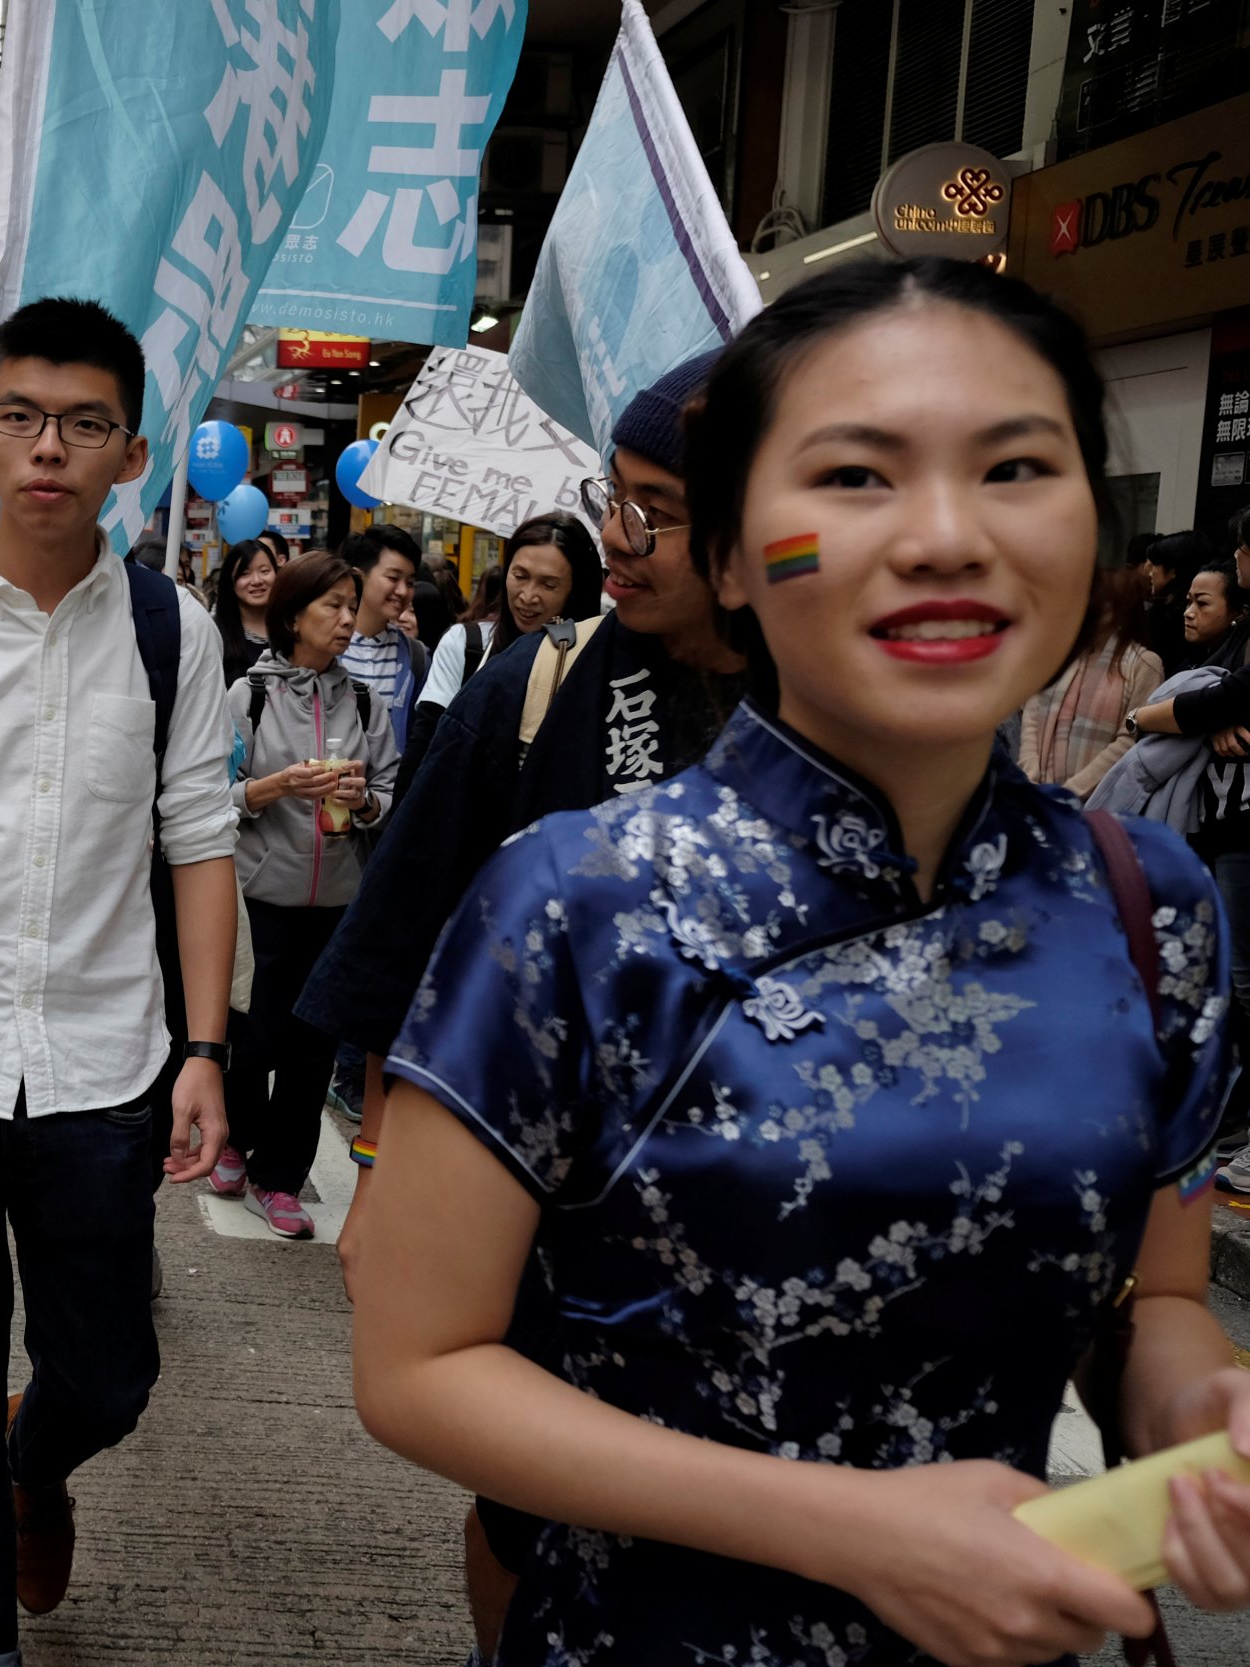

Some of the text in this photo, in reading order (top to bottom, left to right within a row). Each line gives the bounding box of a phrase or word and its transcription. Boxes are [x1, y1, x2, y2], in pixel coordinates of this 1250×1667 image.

[893, 203, 937, 219] China
[1082, 173, 1161, 248] DBS
[389, 430, 469, 477] Give
[481, 467, 533, 495] me
